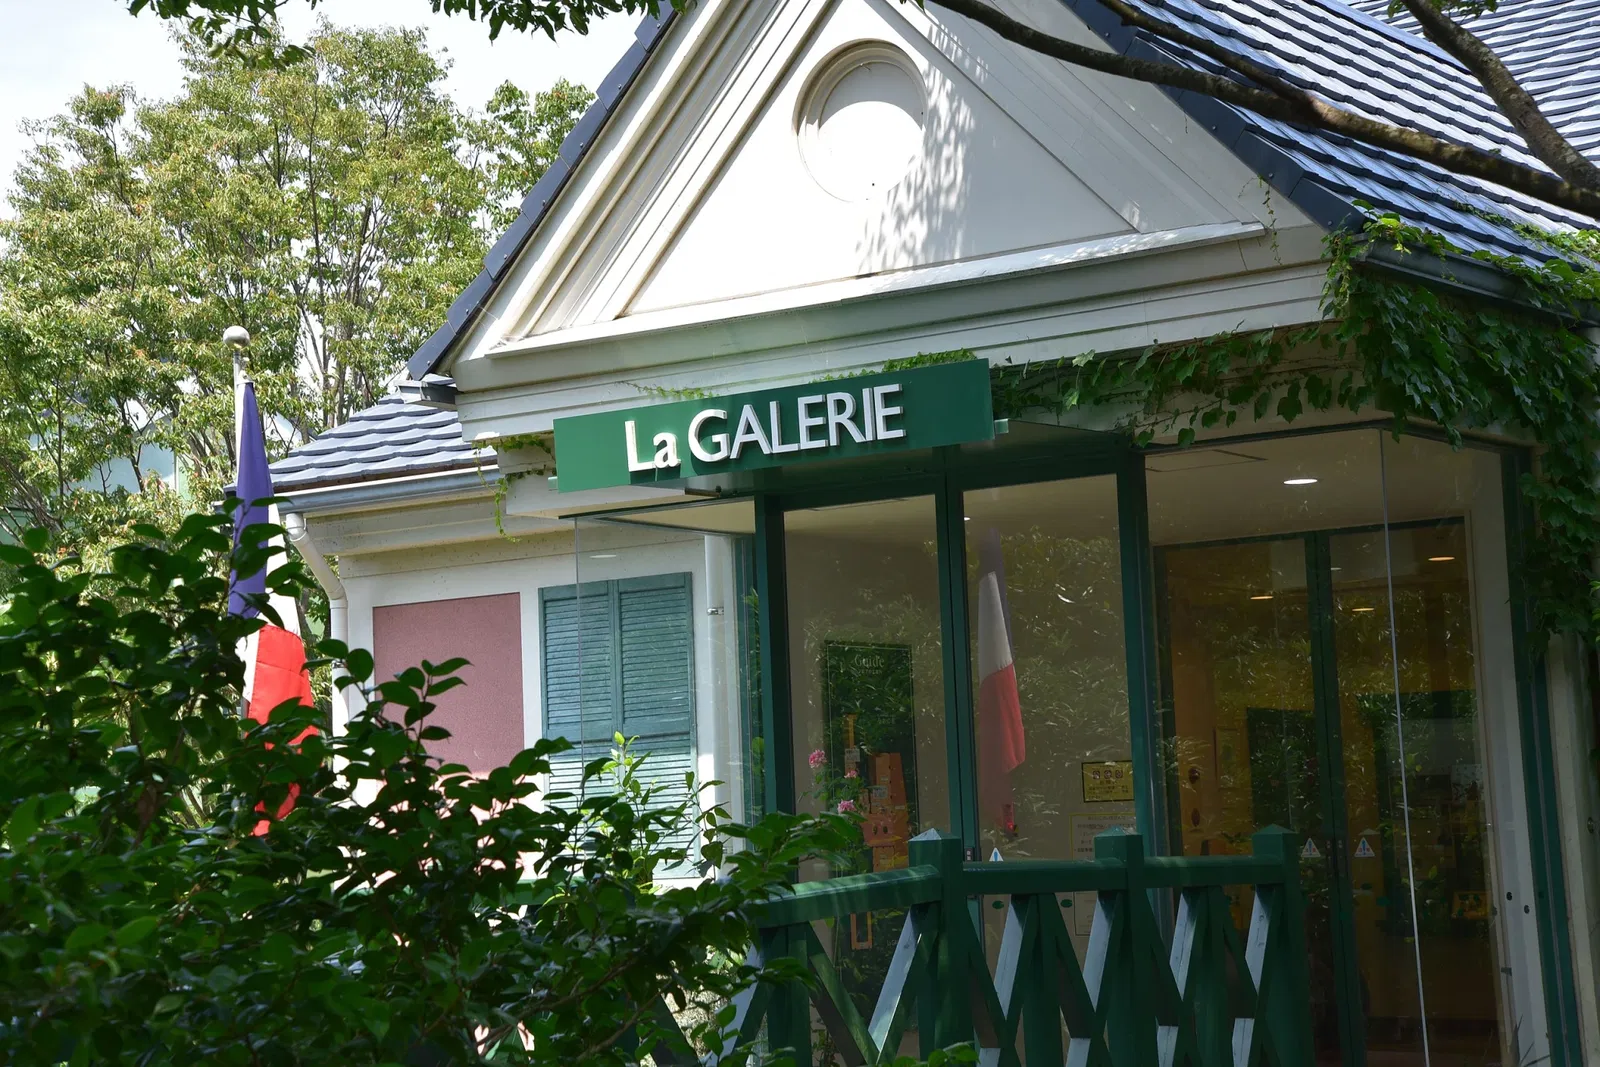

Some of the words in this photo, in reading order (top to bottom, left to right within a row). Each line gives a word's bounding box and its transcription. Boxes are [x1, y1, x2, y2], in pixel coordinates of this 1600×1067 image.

[625, 421, 681, 472] La
[688, 383, 906, 462] GALERIE
[855, 654, 885, 668] Guide
